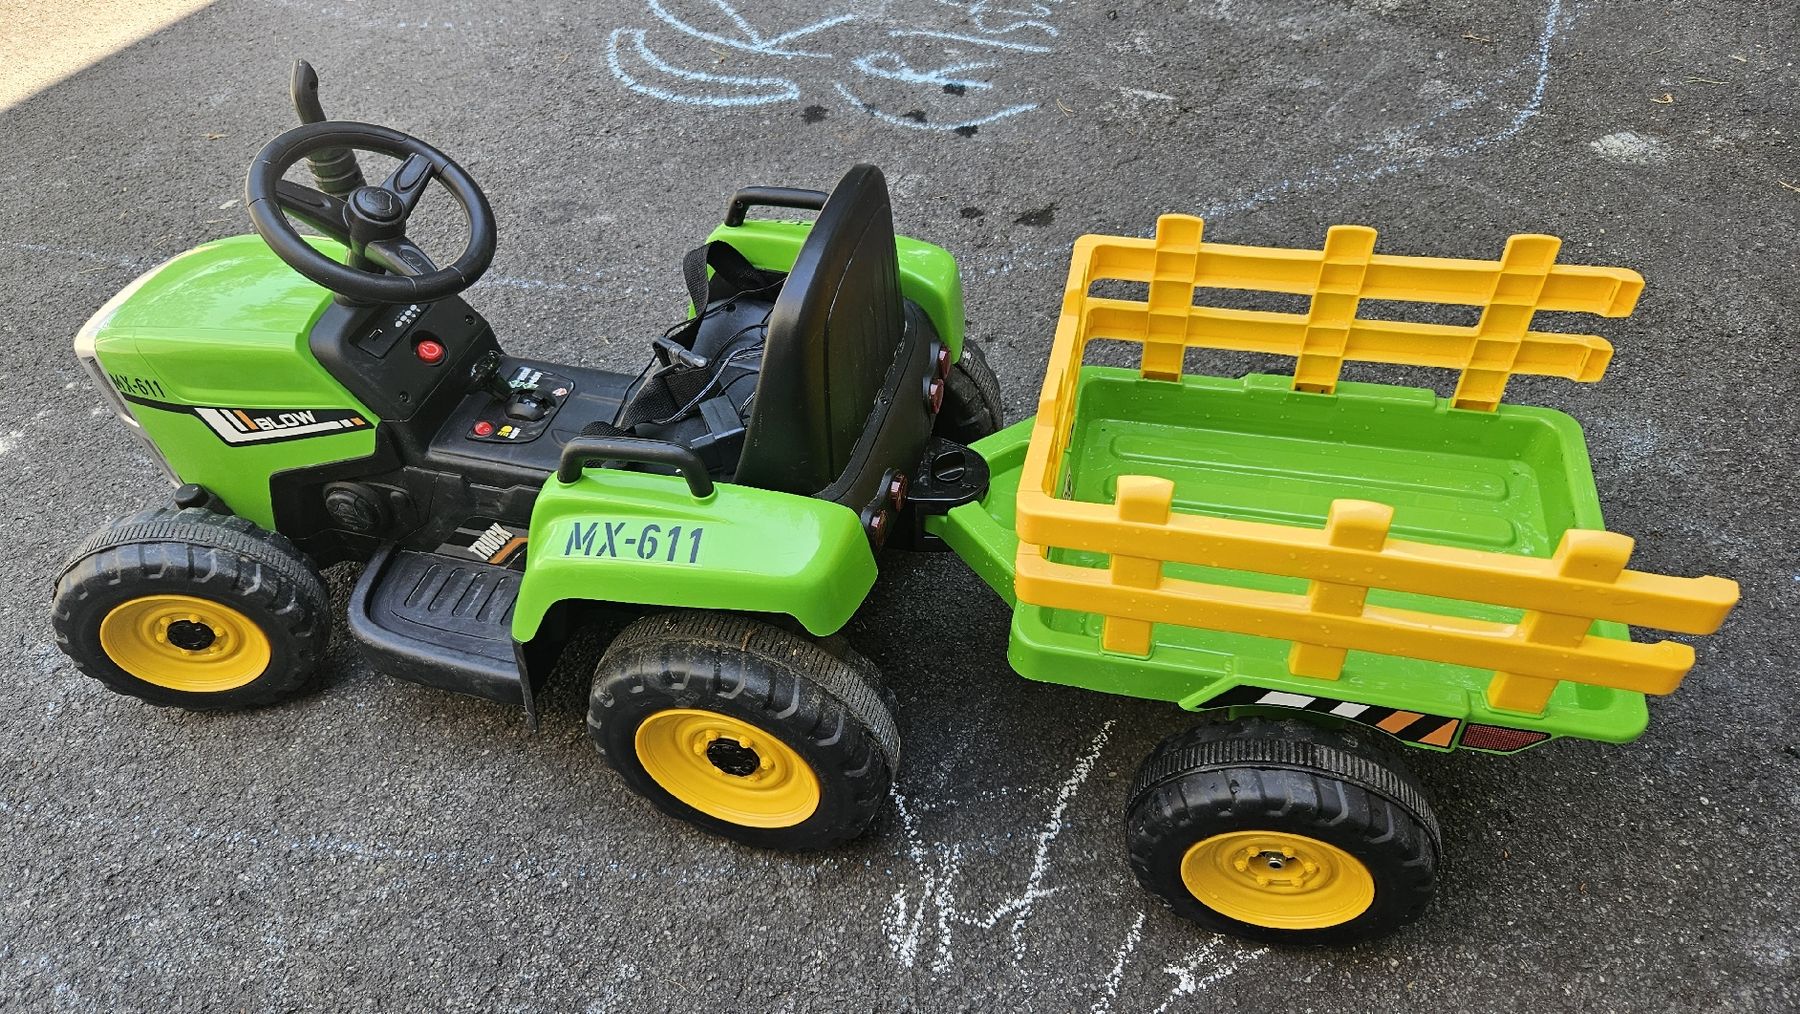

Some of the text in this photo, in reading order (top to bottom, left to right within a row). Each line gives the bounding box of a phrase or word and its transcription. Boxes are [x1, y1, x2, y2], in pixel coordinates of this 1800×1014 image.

[109, 373, 166, 398] MX-611
[253, 410, 316, 431] BLOW
[468, 522, 513, 560] TRUCK
[564, 522, 704, 563] MX-611
